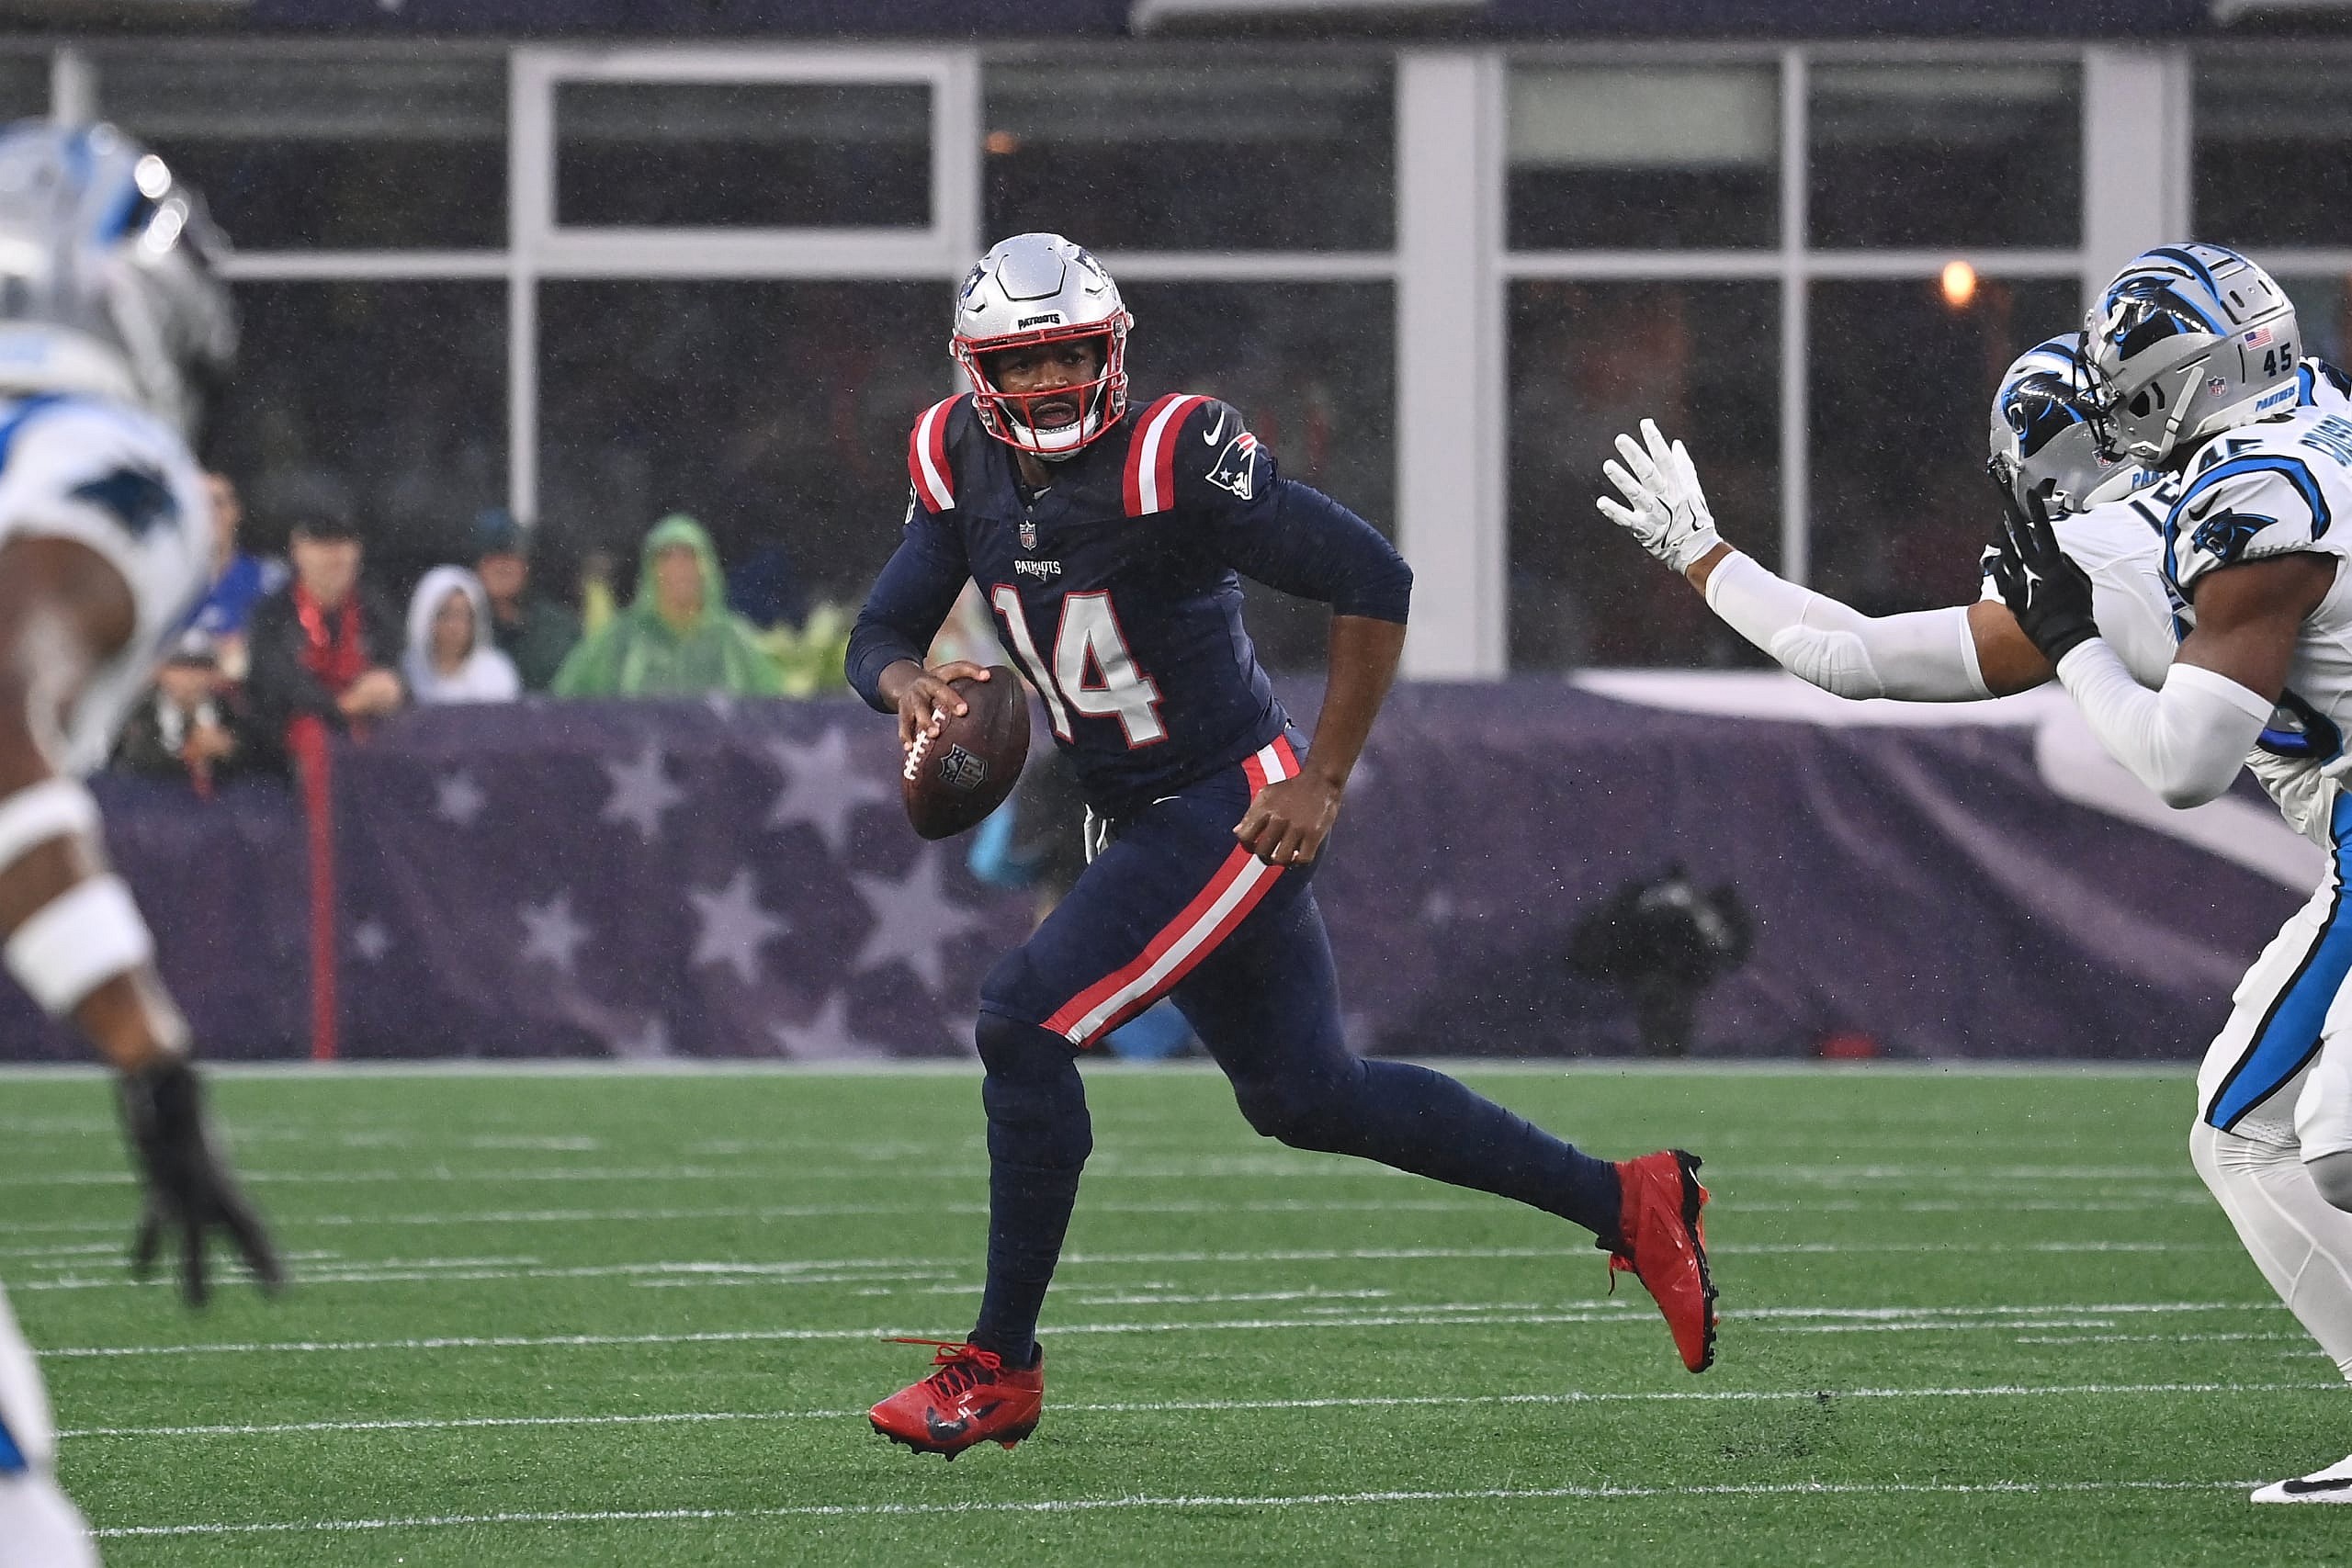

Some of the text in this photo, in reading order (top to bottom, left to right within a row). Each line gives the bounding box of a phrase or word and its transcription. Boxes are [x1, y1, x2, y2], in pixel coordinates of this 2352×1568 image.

[1017, 313, 1061, 331] PATRIOTS
[2263, 342, 2292, 378] 45
[1014, 559, 1062, 577] PATRIOTS
[991, 582, 1169, 750] 14
